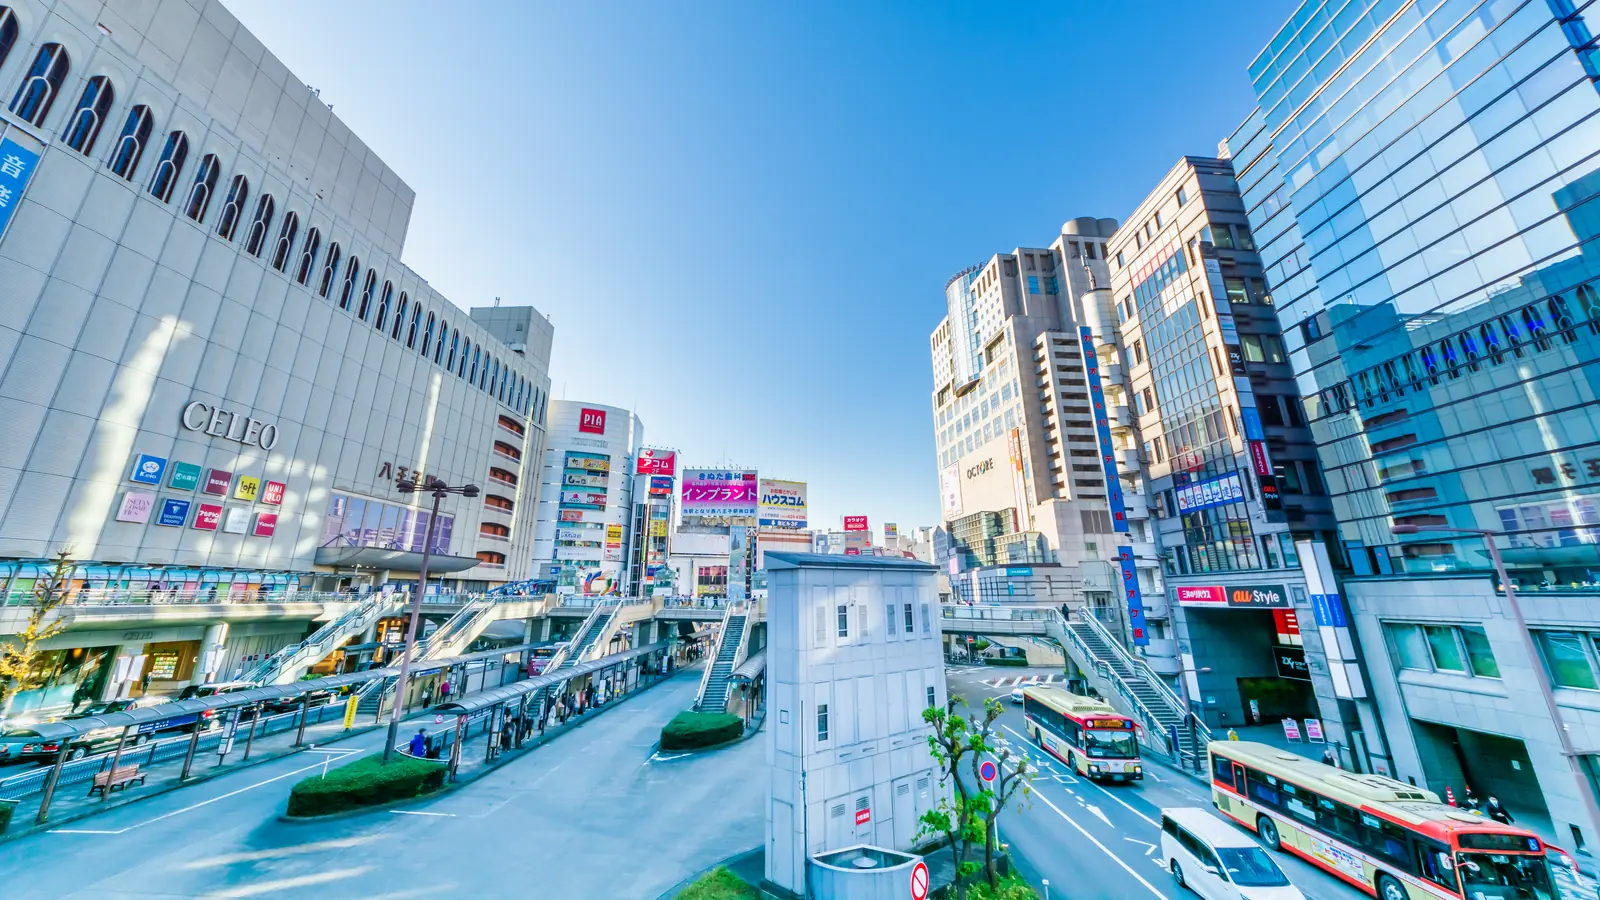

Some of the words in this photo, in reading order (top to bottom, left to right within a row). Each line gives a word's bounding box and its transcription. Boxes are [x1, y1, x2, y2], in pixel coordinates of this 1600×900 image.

[182, 400, 280, 451] CELEO
[583, 413, 602, 426] PIA
[643, 458, 669, 469] アコム
[966, 457, 994, 480] OCTORE
[698, 472, 742, 481] きぬた歯科
[268, 484, 282, 494] UNI
[682, 487, 757, 501] インプラント
[267, 492, 281, 502] QLO
[762, 494, 805, 506] ハウスコム
[1187, 484, 1243, 509] 朝日土地建物
[1121, 552, 1144, 638] カラオケ館
[1182, 589, 1212, 599] 三井のリハウス
[1233, 590, 1253, 603] au
[1252, 589, 1280, 605] Style
